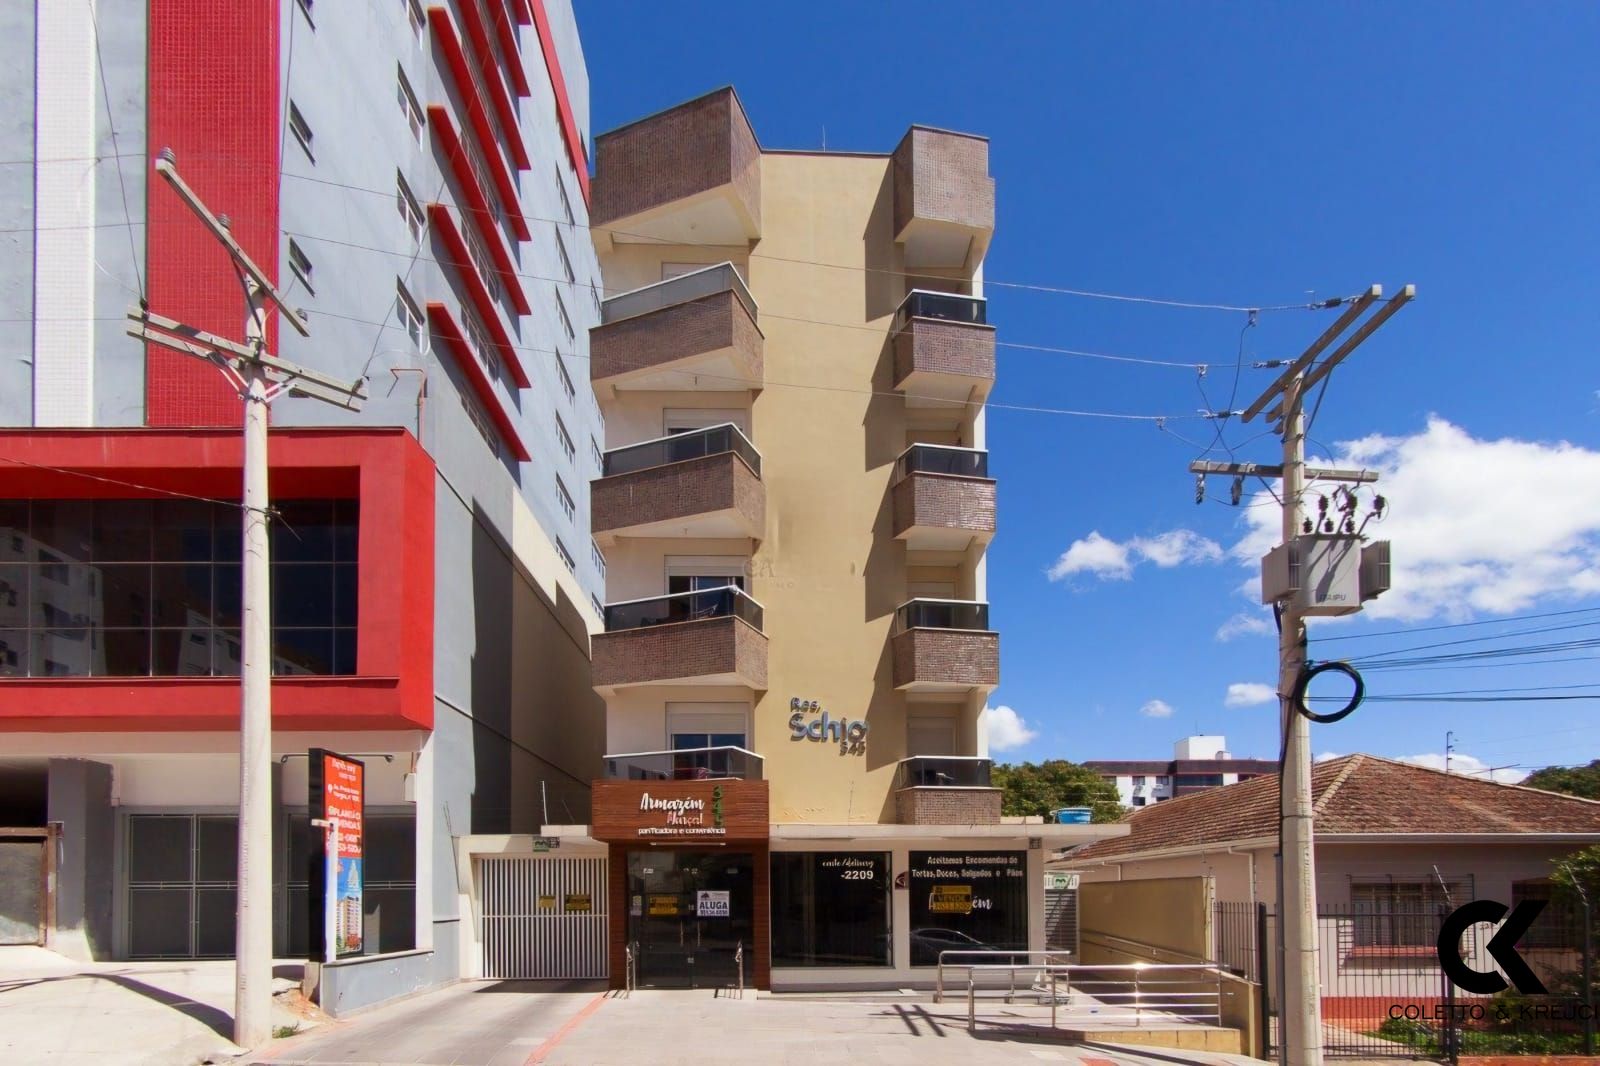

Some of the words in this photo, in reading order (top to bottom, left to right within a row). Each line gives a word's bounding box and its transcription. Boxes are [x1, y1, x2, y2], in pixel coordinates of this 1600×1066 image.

[640, 793, 705, 816] Armazém
[965, 856, 1008, 865] Encomendas
[841, 870, 874, 880] -2209
[961, 869, 992, 878] Salgados
[700, 901, 728, 910] ALUGA
